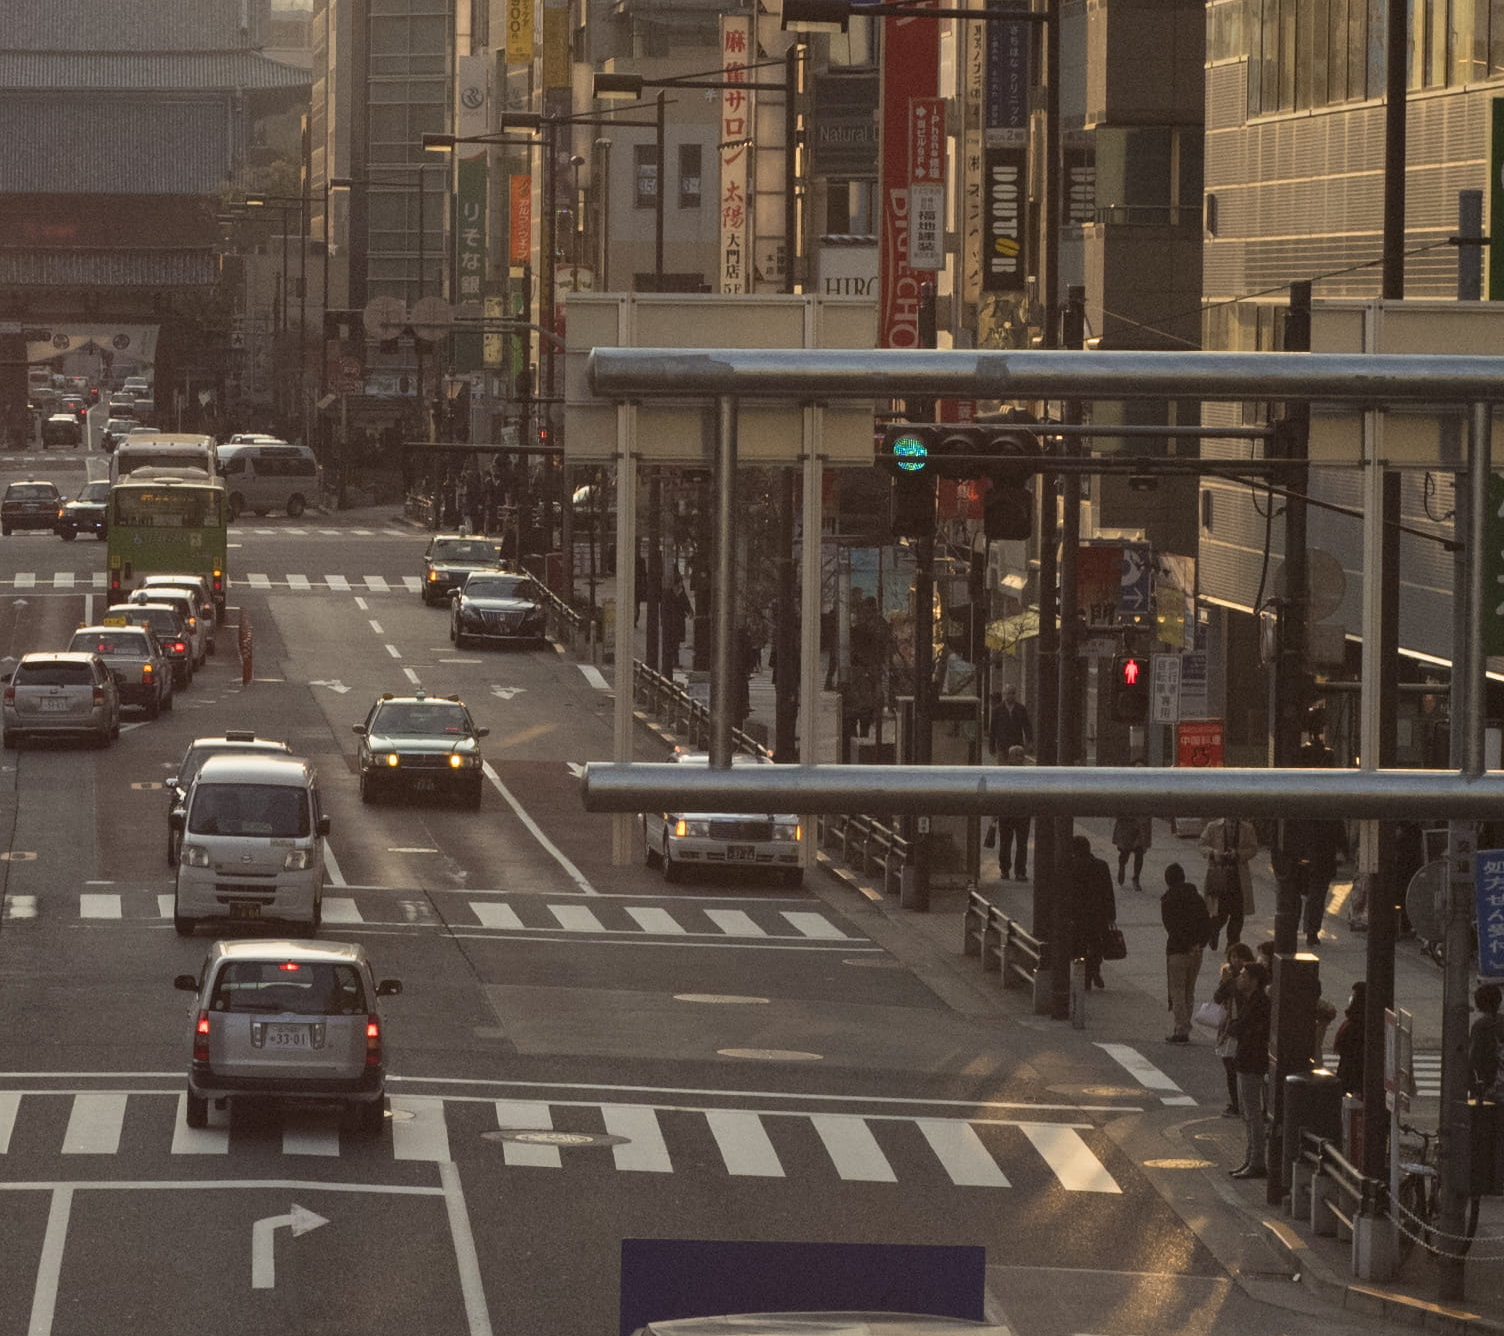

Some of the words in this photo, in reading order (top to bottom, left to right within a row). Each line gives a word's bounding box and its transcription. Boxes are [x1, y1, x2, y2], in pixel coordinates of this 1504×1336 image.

[821, 125, 869, 143] Natural
[723, 181, 743, 229] 太陽
[992, 166, 1020, 273] DOUTOR
[725, 232, 740, 280] 大門店
